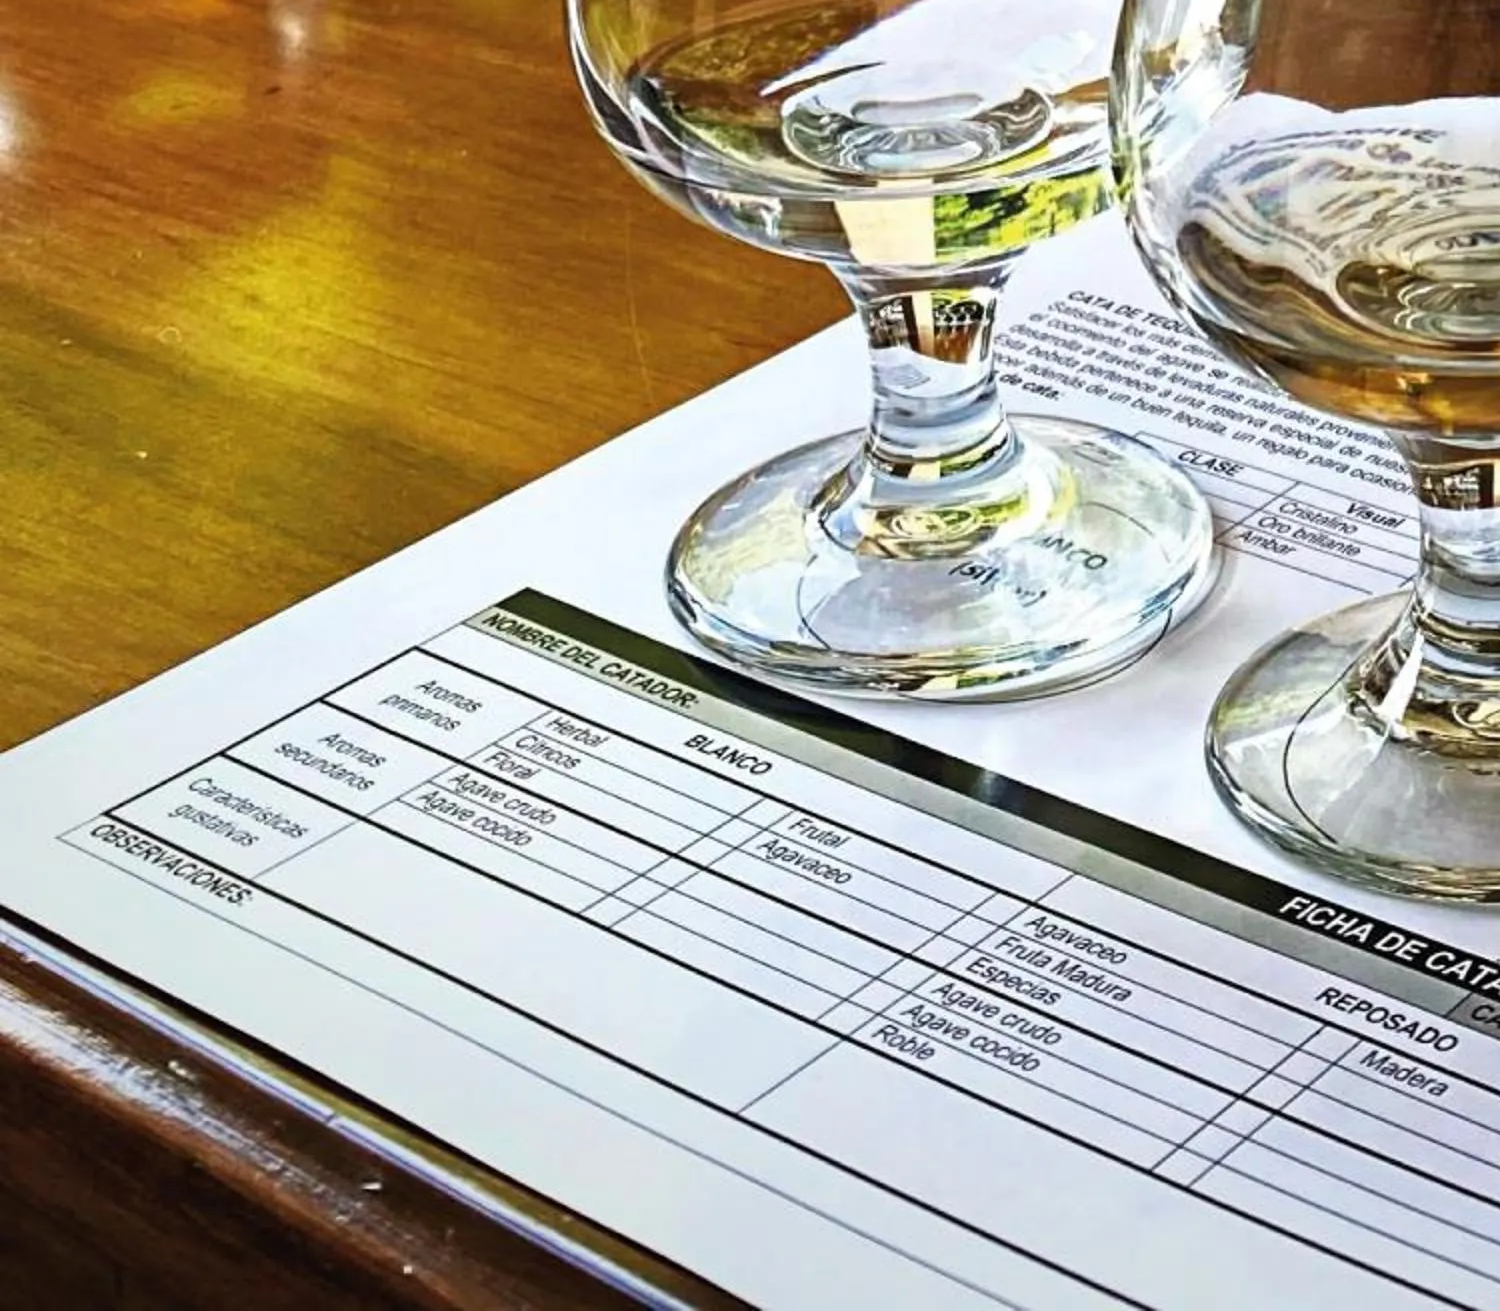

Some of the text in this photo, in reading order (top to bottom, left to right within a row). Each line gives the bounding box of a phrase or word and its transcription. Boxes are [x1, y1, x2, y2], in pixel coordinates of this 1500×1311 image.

[1068, 291, 1115, 310] CATA
[1115, 305, 1144, 319] DE
[1206, 402, 1363, 458] reserva especial de
[1243, 397, 1320, 426] naturales
[1178, 450, 1244, 477] CLASE
[1232, 431, 1256, 443] un
[1256, 437, 1308, 459] regalo
[1306, 455, 1350, 474] para
[1258, 516, 1361, 556] Oro brillante
[1279, 501, 1358, 534] Cristalino
[1346, 503, 1406, 528] Visual
[482, 613, 700, 709] NOMBRE DEL CATADOR:
[378, 694, 461, 732] primarios
[415, 680, 482, 713] Aromas
[318, 732, 387, 768] Aromas
[546, 716, 607, 747] Herbal
[275, 741, 375, 792] secundarios
[483, 752, 540, 779] Floral
[684, 735, 773, 775] BLANCO
[416, 789, 533, 847] Agave cocido
[449, 772, 557, 825] Agave crudo
[168, 803, 260, 847] gustativas
[788, 818, 849, 848] Frutal
[90, 823, 254, 906] OBSERVACIONES:
[756, 838, 852, 884] Agavaceo
[1024, 916, 1127, 965] Agavaceo
[1280, 897, 1373, 944] FICHA
[1376, 932, 1429, 961] DE
[965, 957, 1062, 1006] Especias
[995, 937, 1132, 1002] Fruta Madura
[930, 982, 1062, 1046] Agave crudo
[1315, 986, 1459, 1052] REPOSADO
[872, 1024, 935, 1061] Roble
[900, 1004, 1040, 1072] Agave cocido
[1360, 1050, 1449, 1096] Madera
